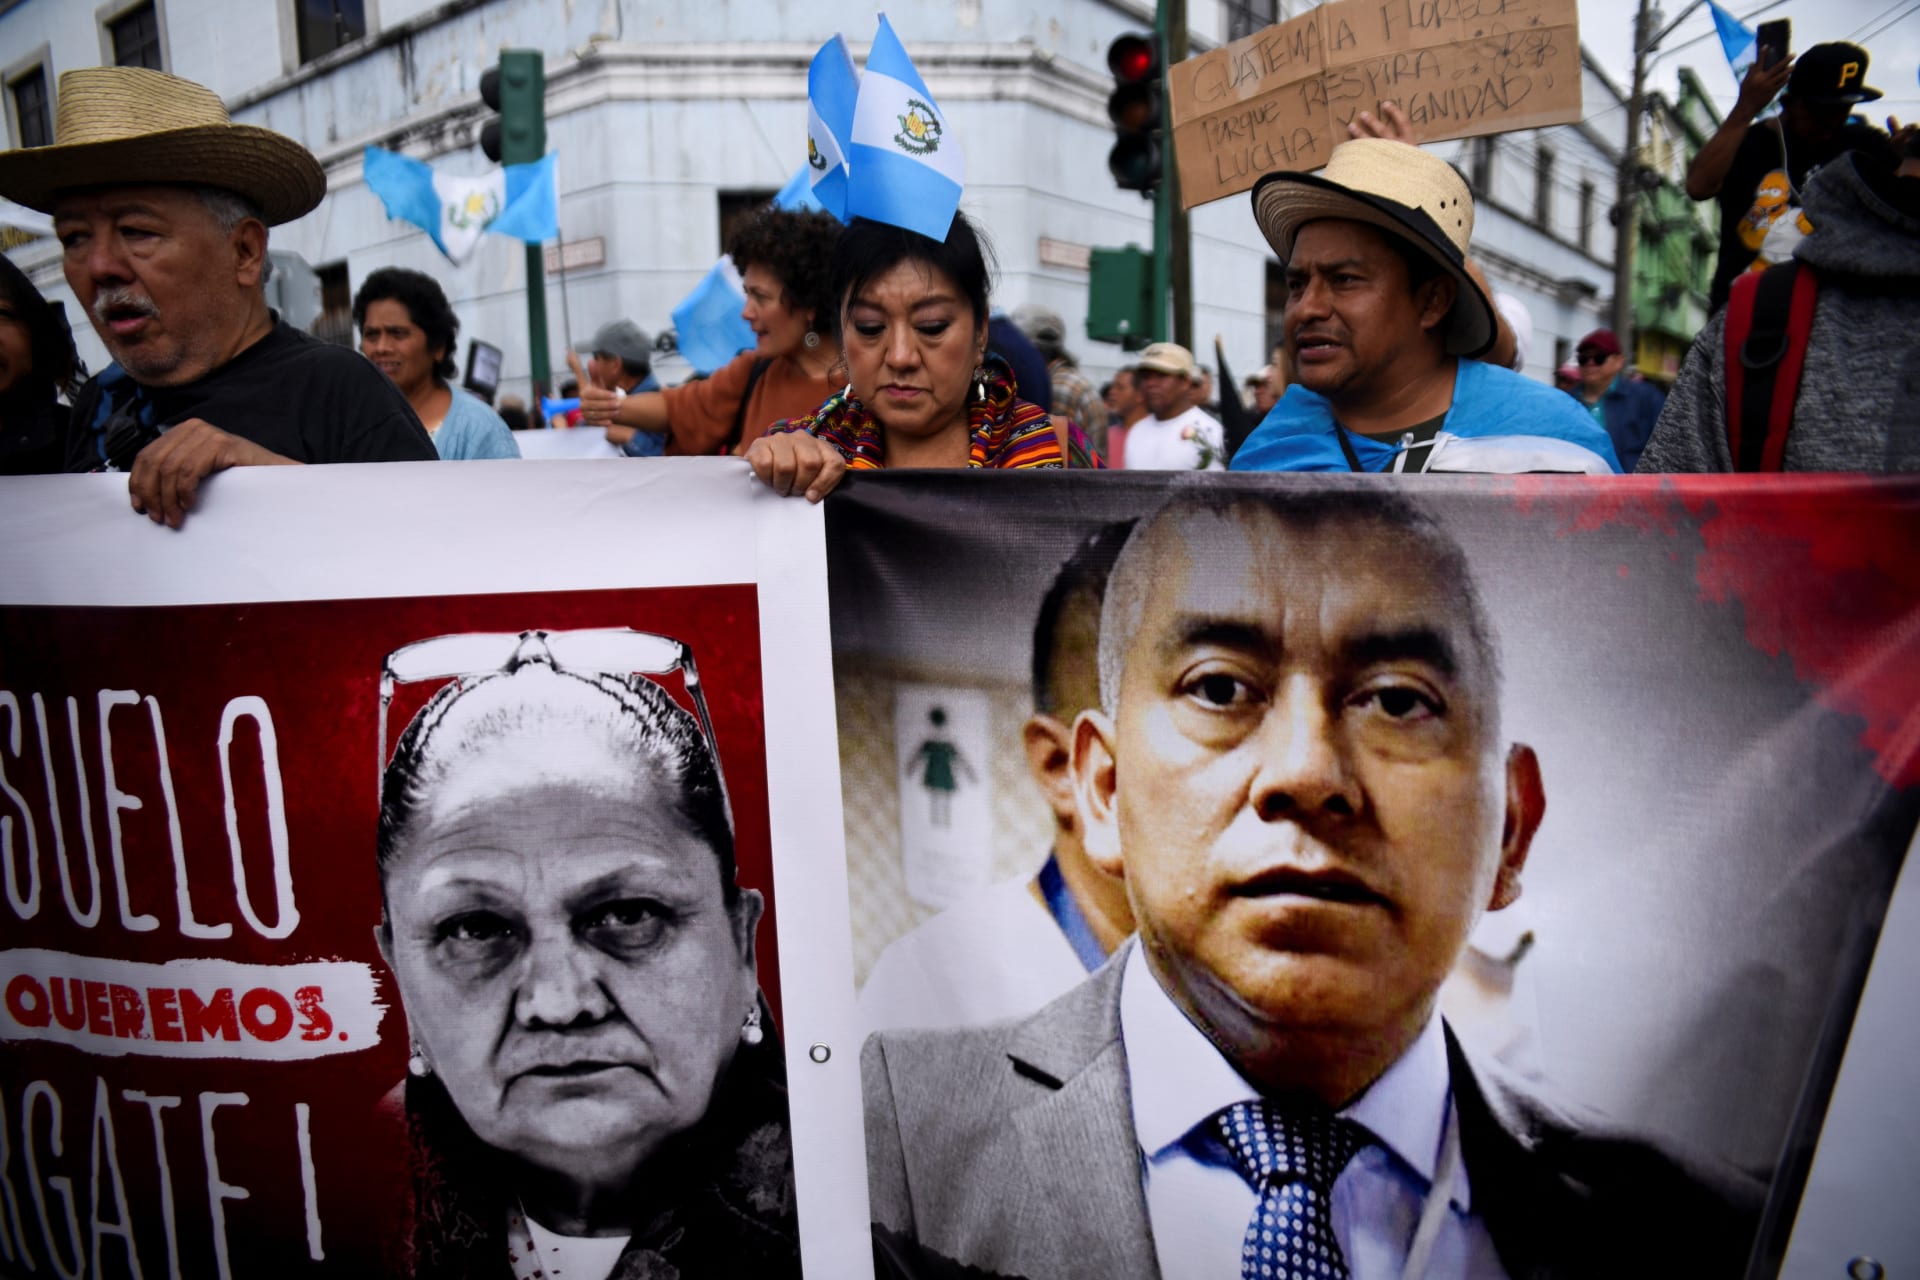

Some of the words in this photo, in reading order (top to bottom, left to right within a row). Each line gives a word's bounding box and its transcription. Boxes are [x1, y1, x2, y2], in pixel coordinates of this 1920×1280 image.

[1193, 18, 1357, 103] GUATEMALA
[1299, 50, 1442, 117] RESPIRA
[1838, 61, 1859, 88] P
[1216, 127, 1318, 184] LUCHA
[5, 974, 349, 1042] QUEREMOS.
